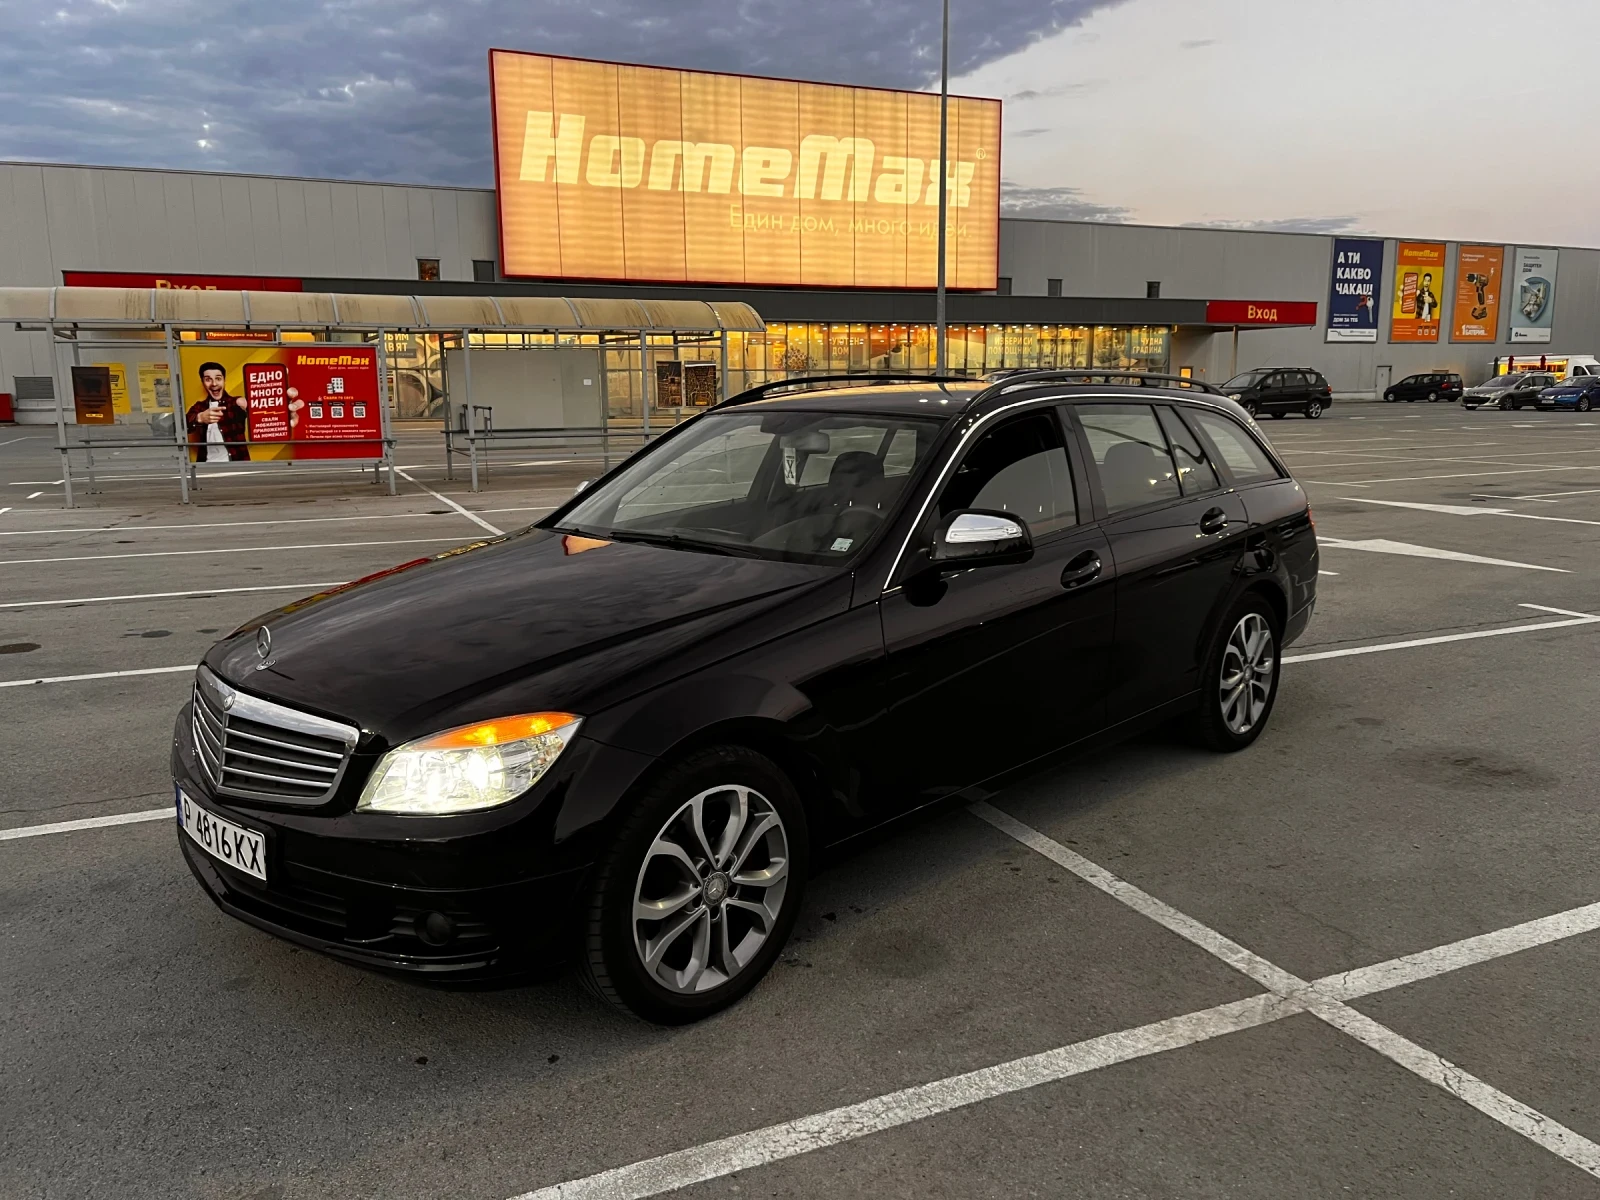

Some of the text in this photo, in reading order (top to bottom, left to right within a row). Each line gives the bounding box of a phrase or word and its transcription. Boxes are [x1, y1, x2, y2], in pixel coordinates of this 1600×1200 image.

[519, 110, 975, 208] HomeMax
[729, 203, 783, 233] Един
[789, 214, 839, 236] дом,
[848, 218, 912, 236] много
[1337, 251, 1360, 264] А ТИ
[1336, 267, 1371, 280] КАКВО
[1247, 305, 1278, 321] Вход
[297, 355, 370, 365] HomeMax
[249, 370, 283, 384] ЕДНО
[250, 388, 283, 398] МНОГО
[250, 397, 283, 409] ИДЕИ
[183, 797, 191, 828] P
